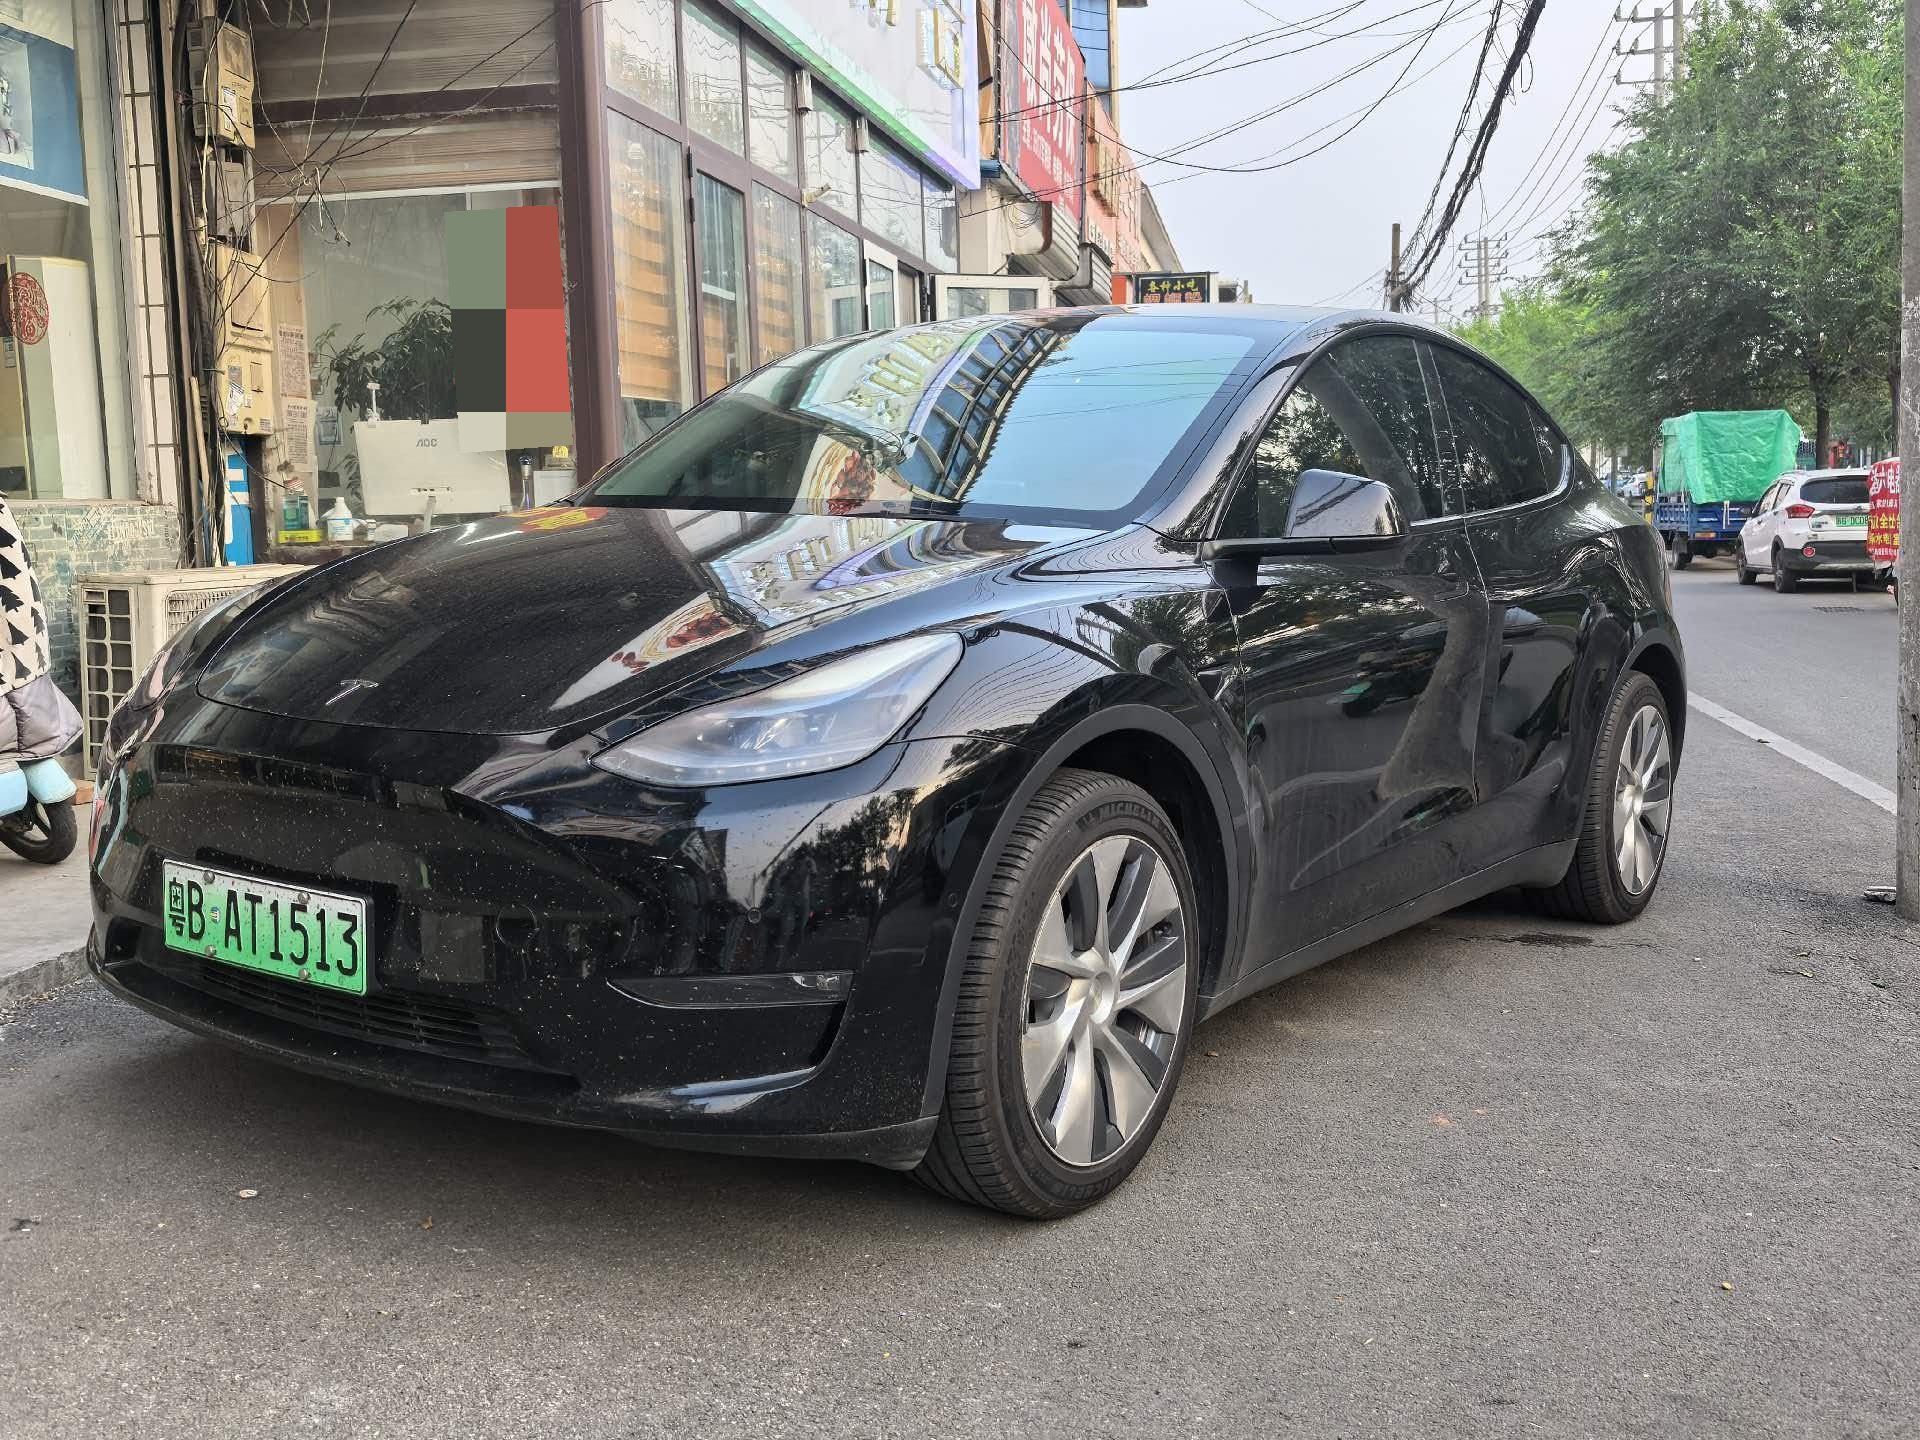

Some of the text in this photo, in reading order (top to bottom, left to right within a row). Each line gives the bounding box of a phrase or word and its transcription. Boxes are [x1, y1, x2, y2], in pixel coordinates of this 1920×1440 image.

[1147, 278, 1199, 293] 各种小吃
[416, 438, 438, 448] AOC
[168, 877, 358, 976] 粤B AT1513
